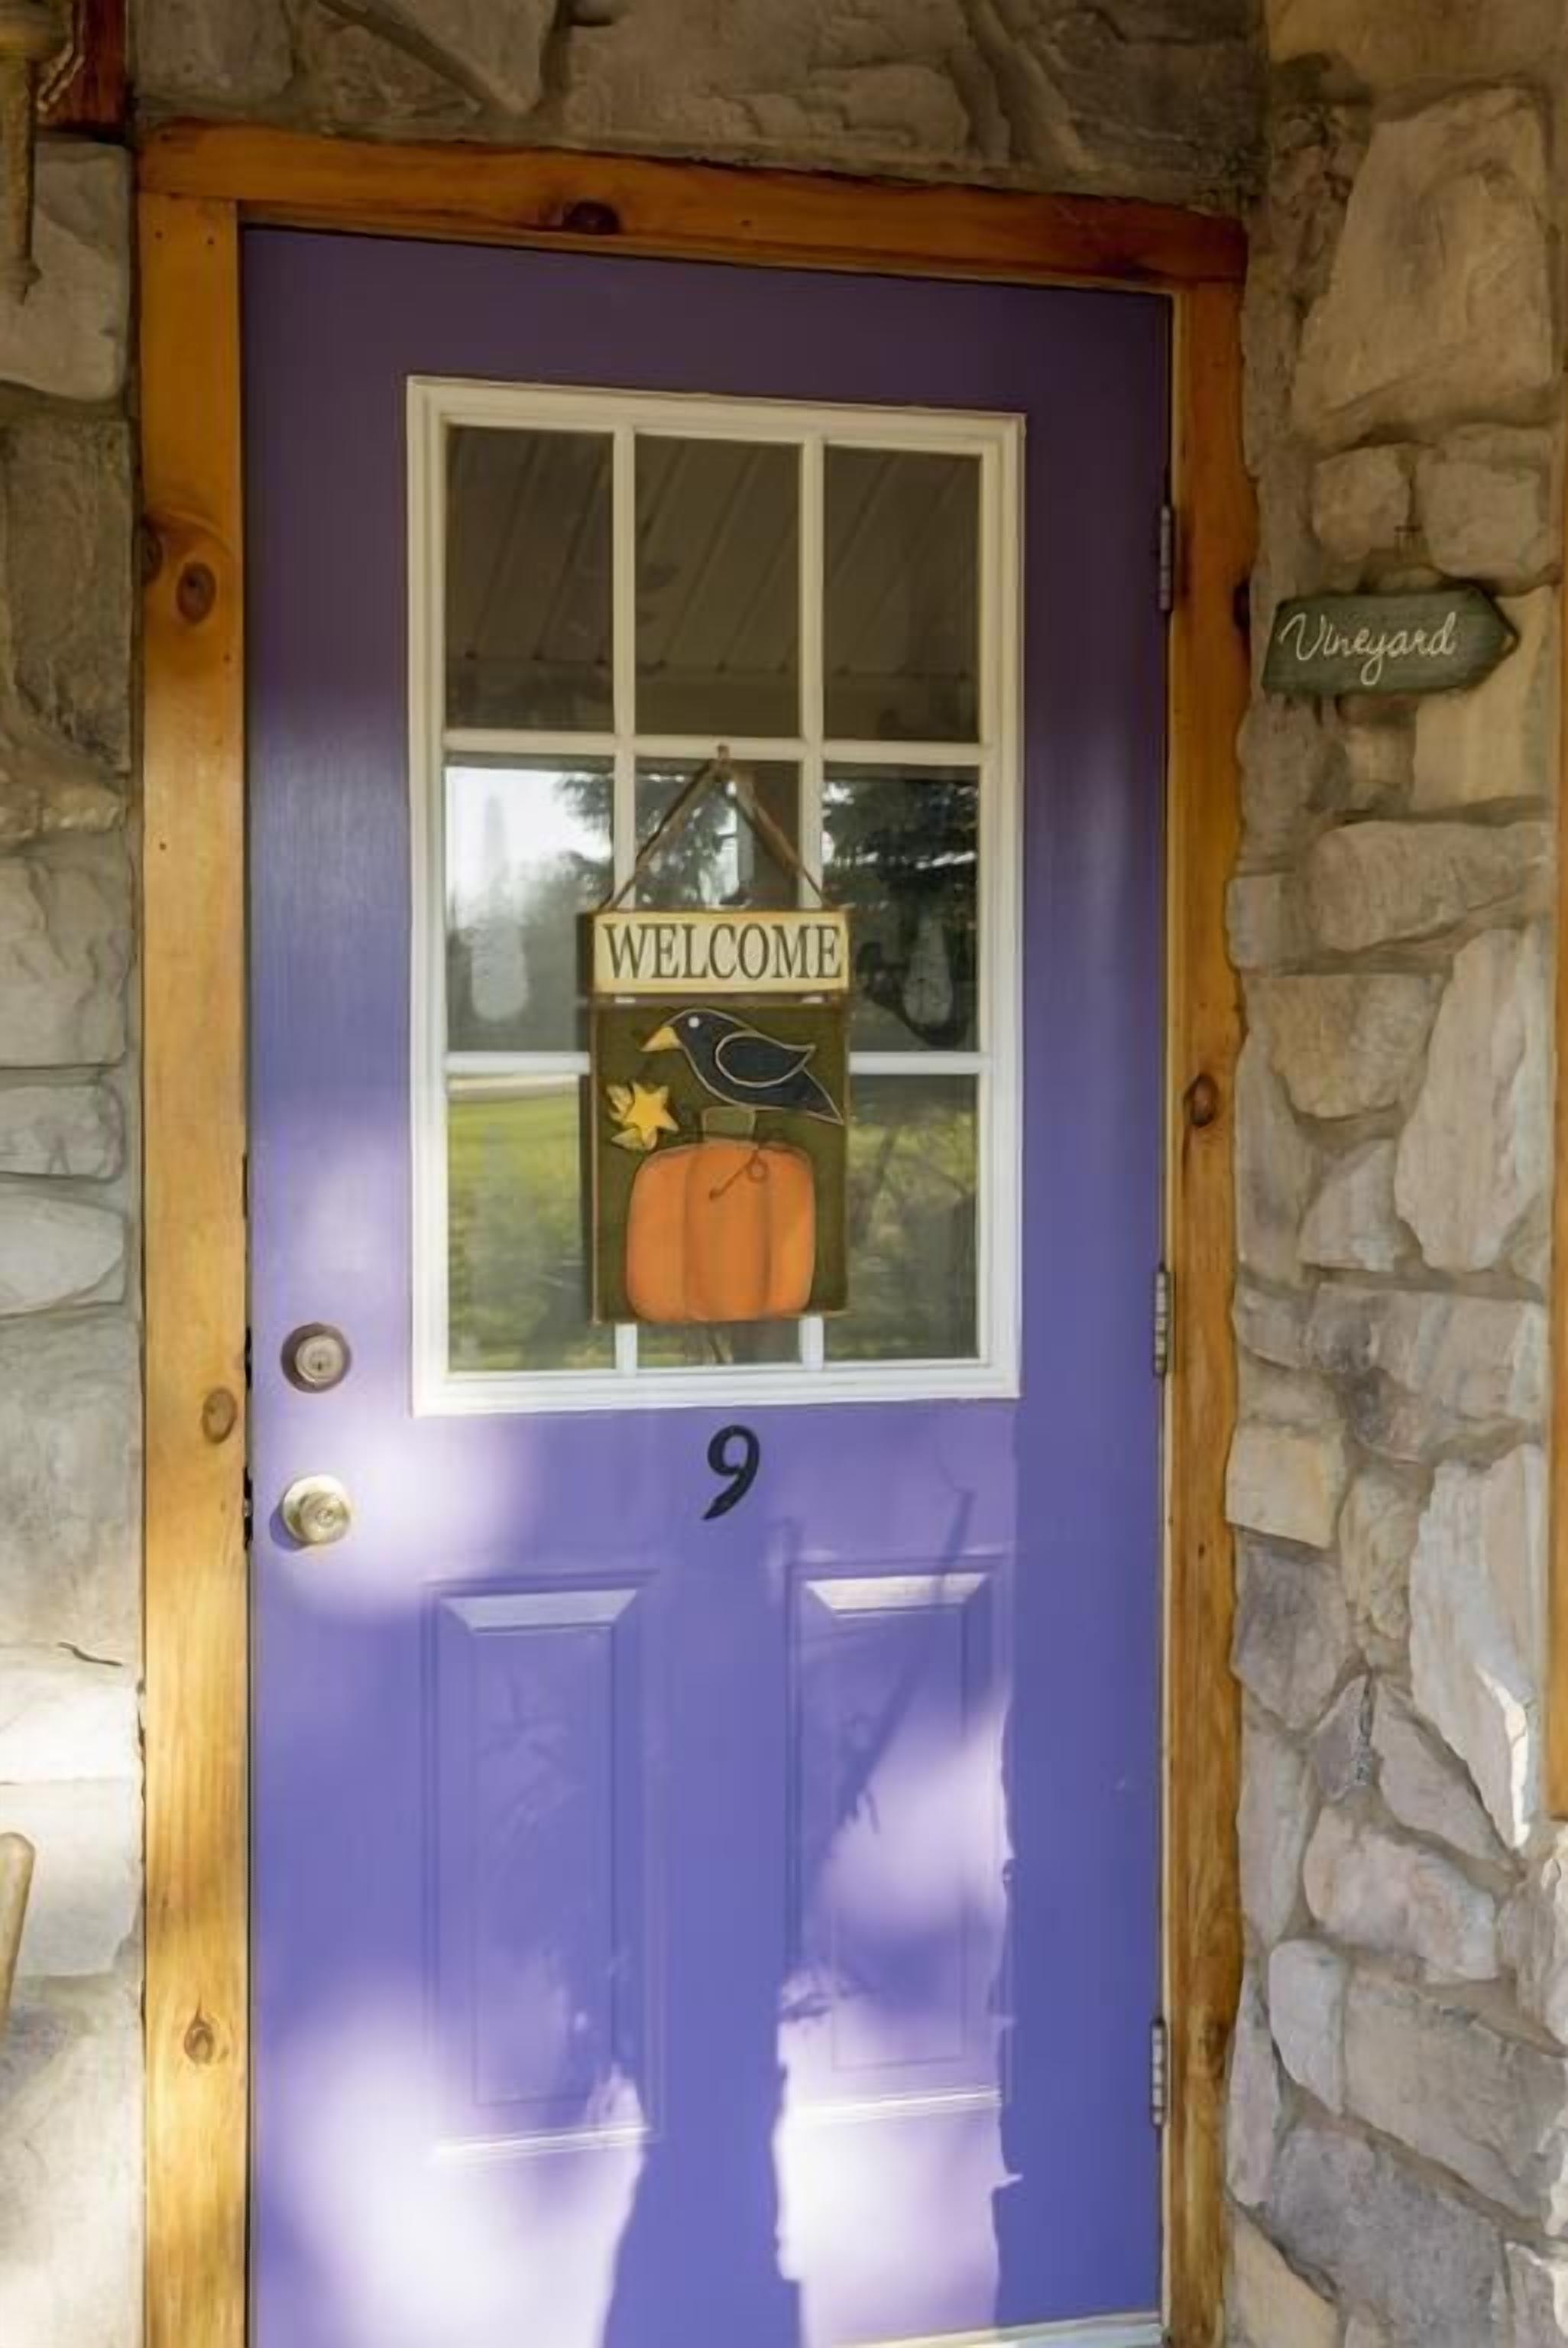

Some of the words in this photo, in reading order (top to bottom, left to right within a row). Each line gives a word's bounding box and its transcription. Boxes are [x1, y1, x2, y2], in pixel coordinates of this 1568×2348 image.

[1278, 611, 1456, 685] Vineyard
[602, 923, 843, 979] WELCOME
[701, 1425, 760, 1520] 9
